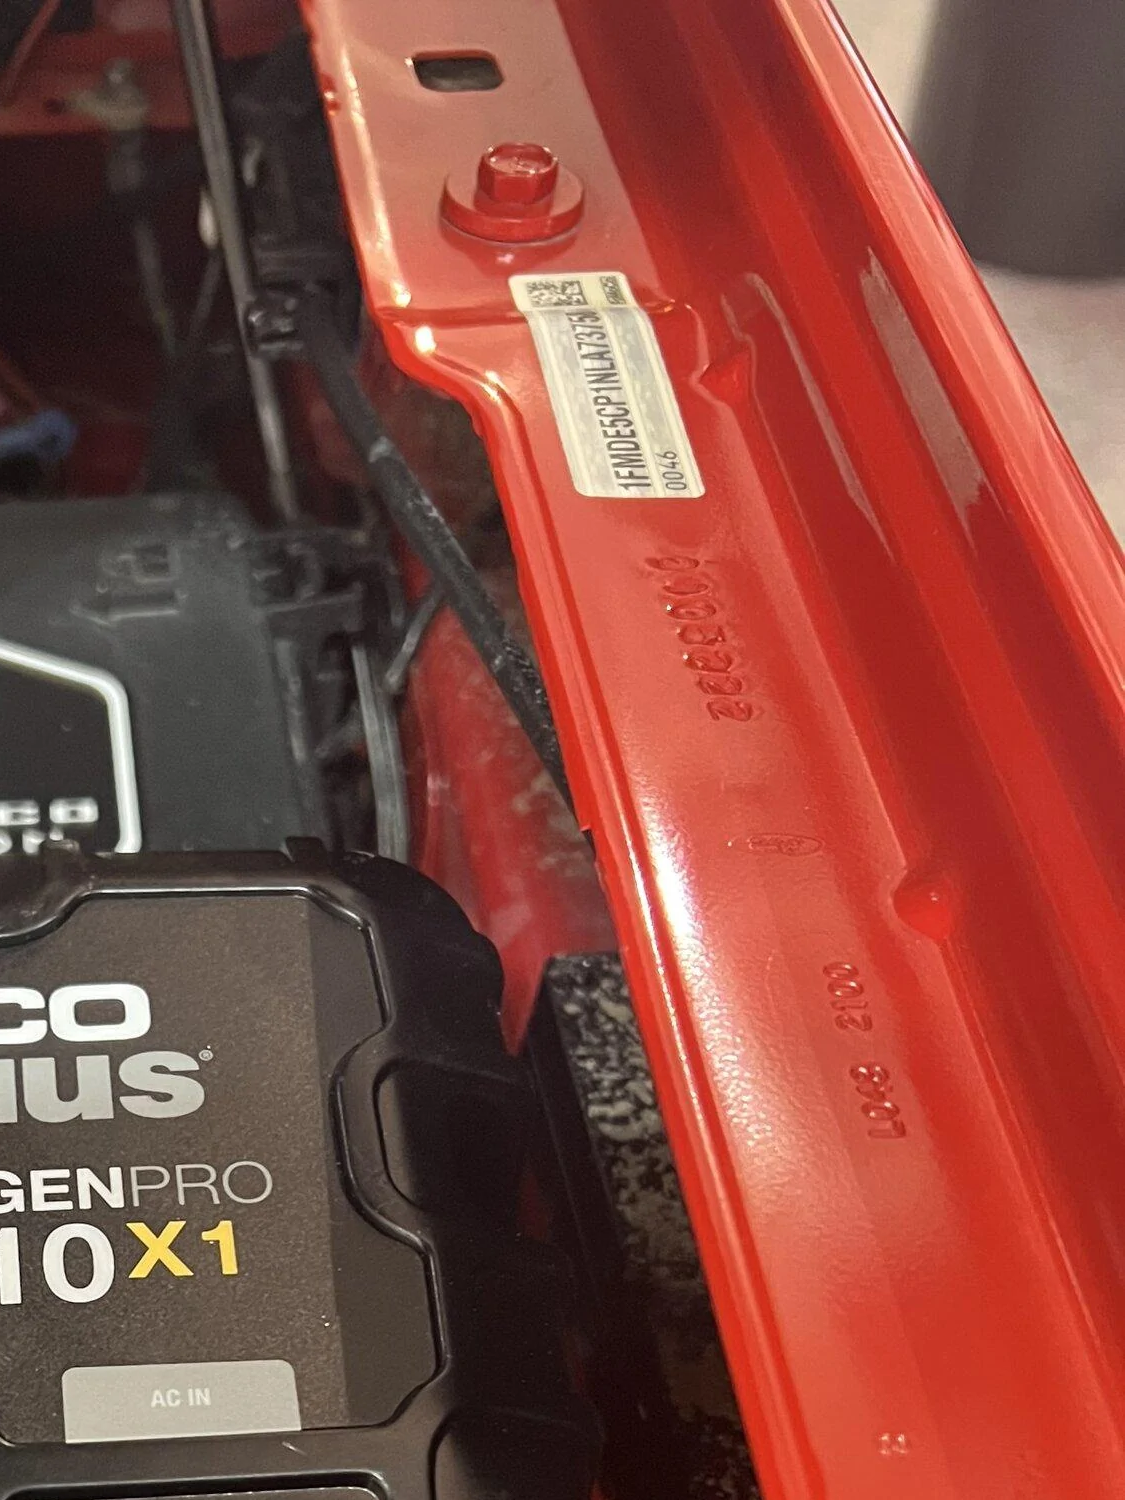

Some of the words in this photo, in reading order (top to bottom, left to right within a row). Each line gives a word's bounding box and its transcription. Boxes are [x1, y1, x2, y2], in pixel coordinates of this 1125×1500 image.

[656, 451, 688, 491] 0046
[151, 1389, 180, 1409] AC
[186, 1388, 212, 1407] IN
